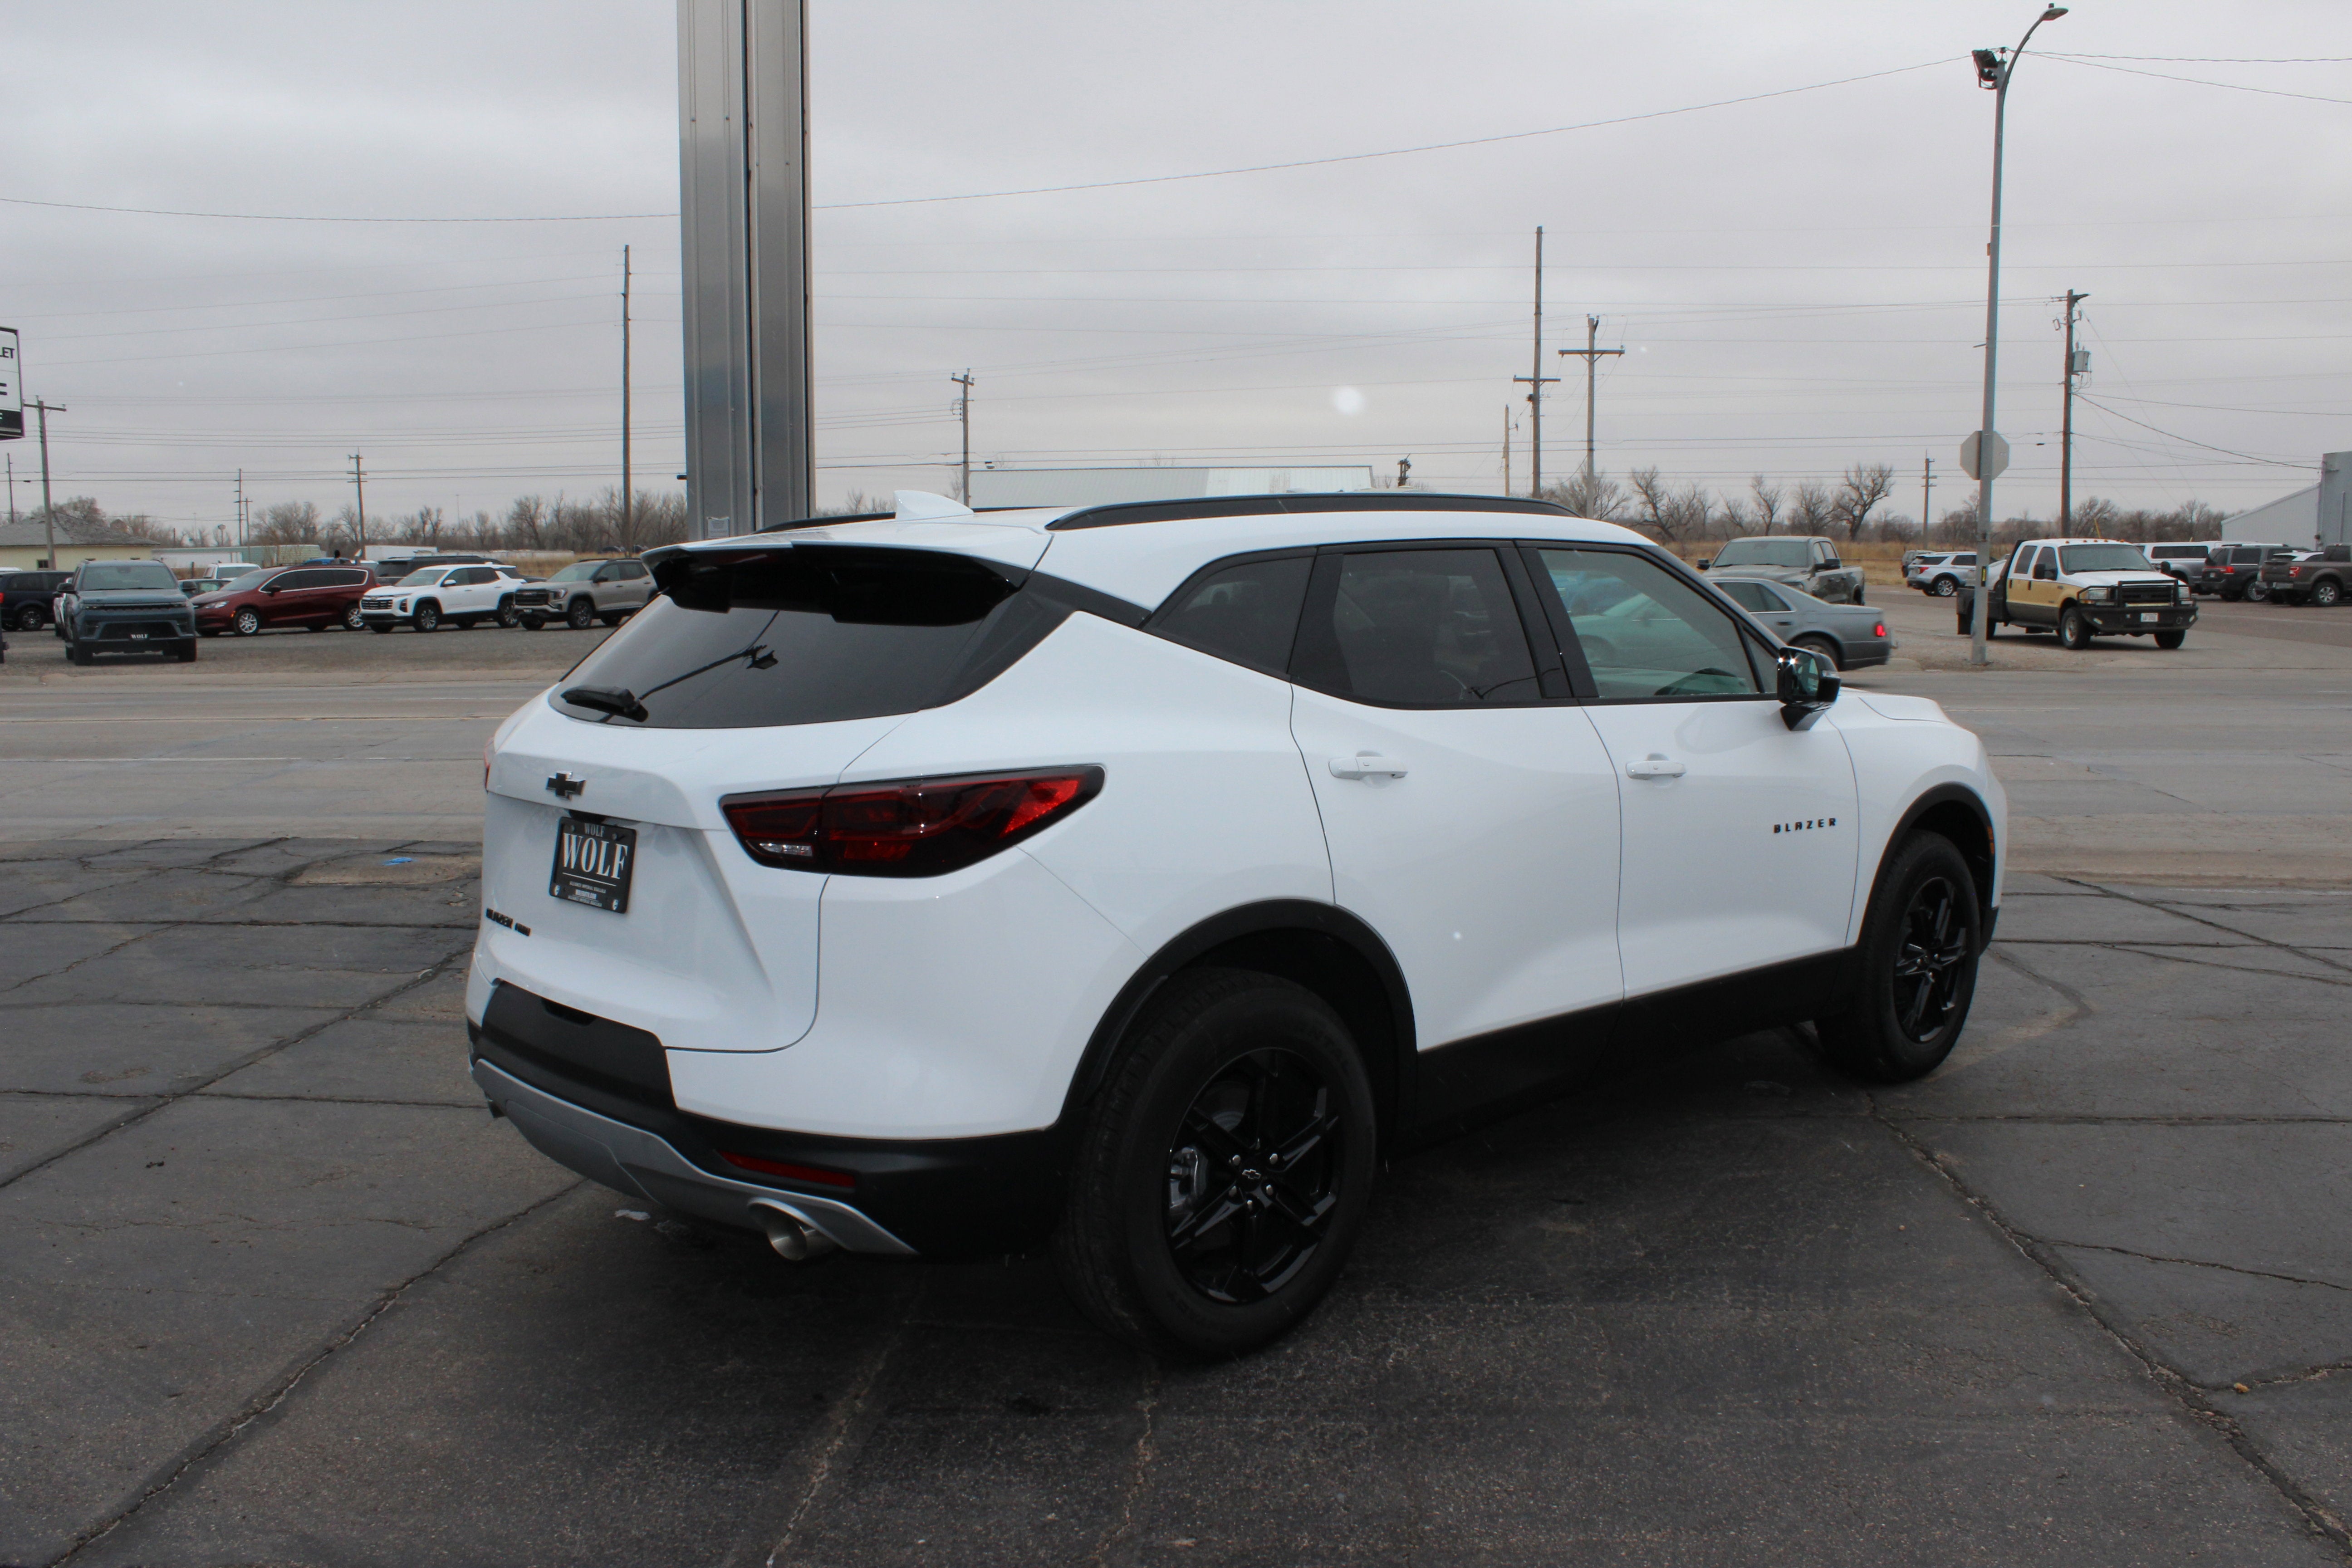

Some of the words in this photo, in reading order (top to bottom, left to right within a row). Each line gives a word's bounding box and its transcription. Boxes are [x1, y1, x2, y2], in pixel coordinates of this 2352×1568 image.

[585, 823, 605, 837] WOLF
[1774, 818, 1836, 833] BLAZER
[563, 833, 628, 879] WOLF
